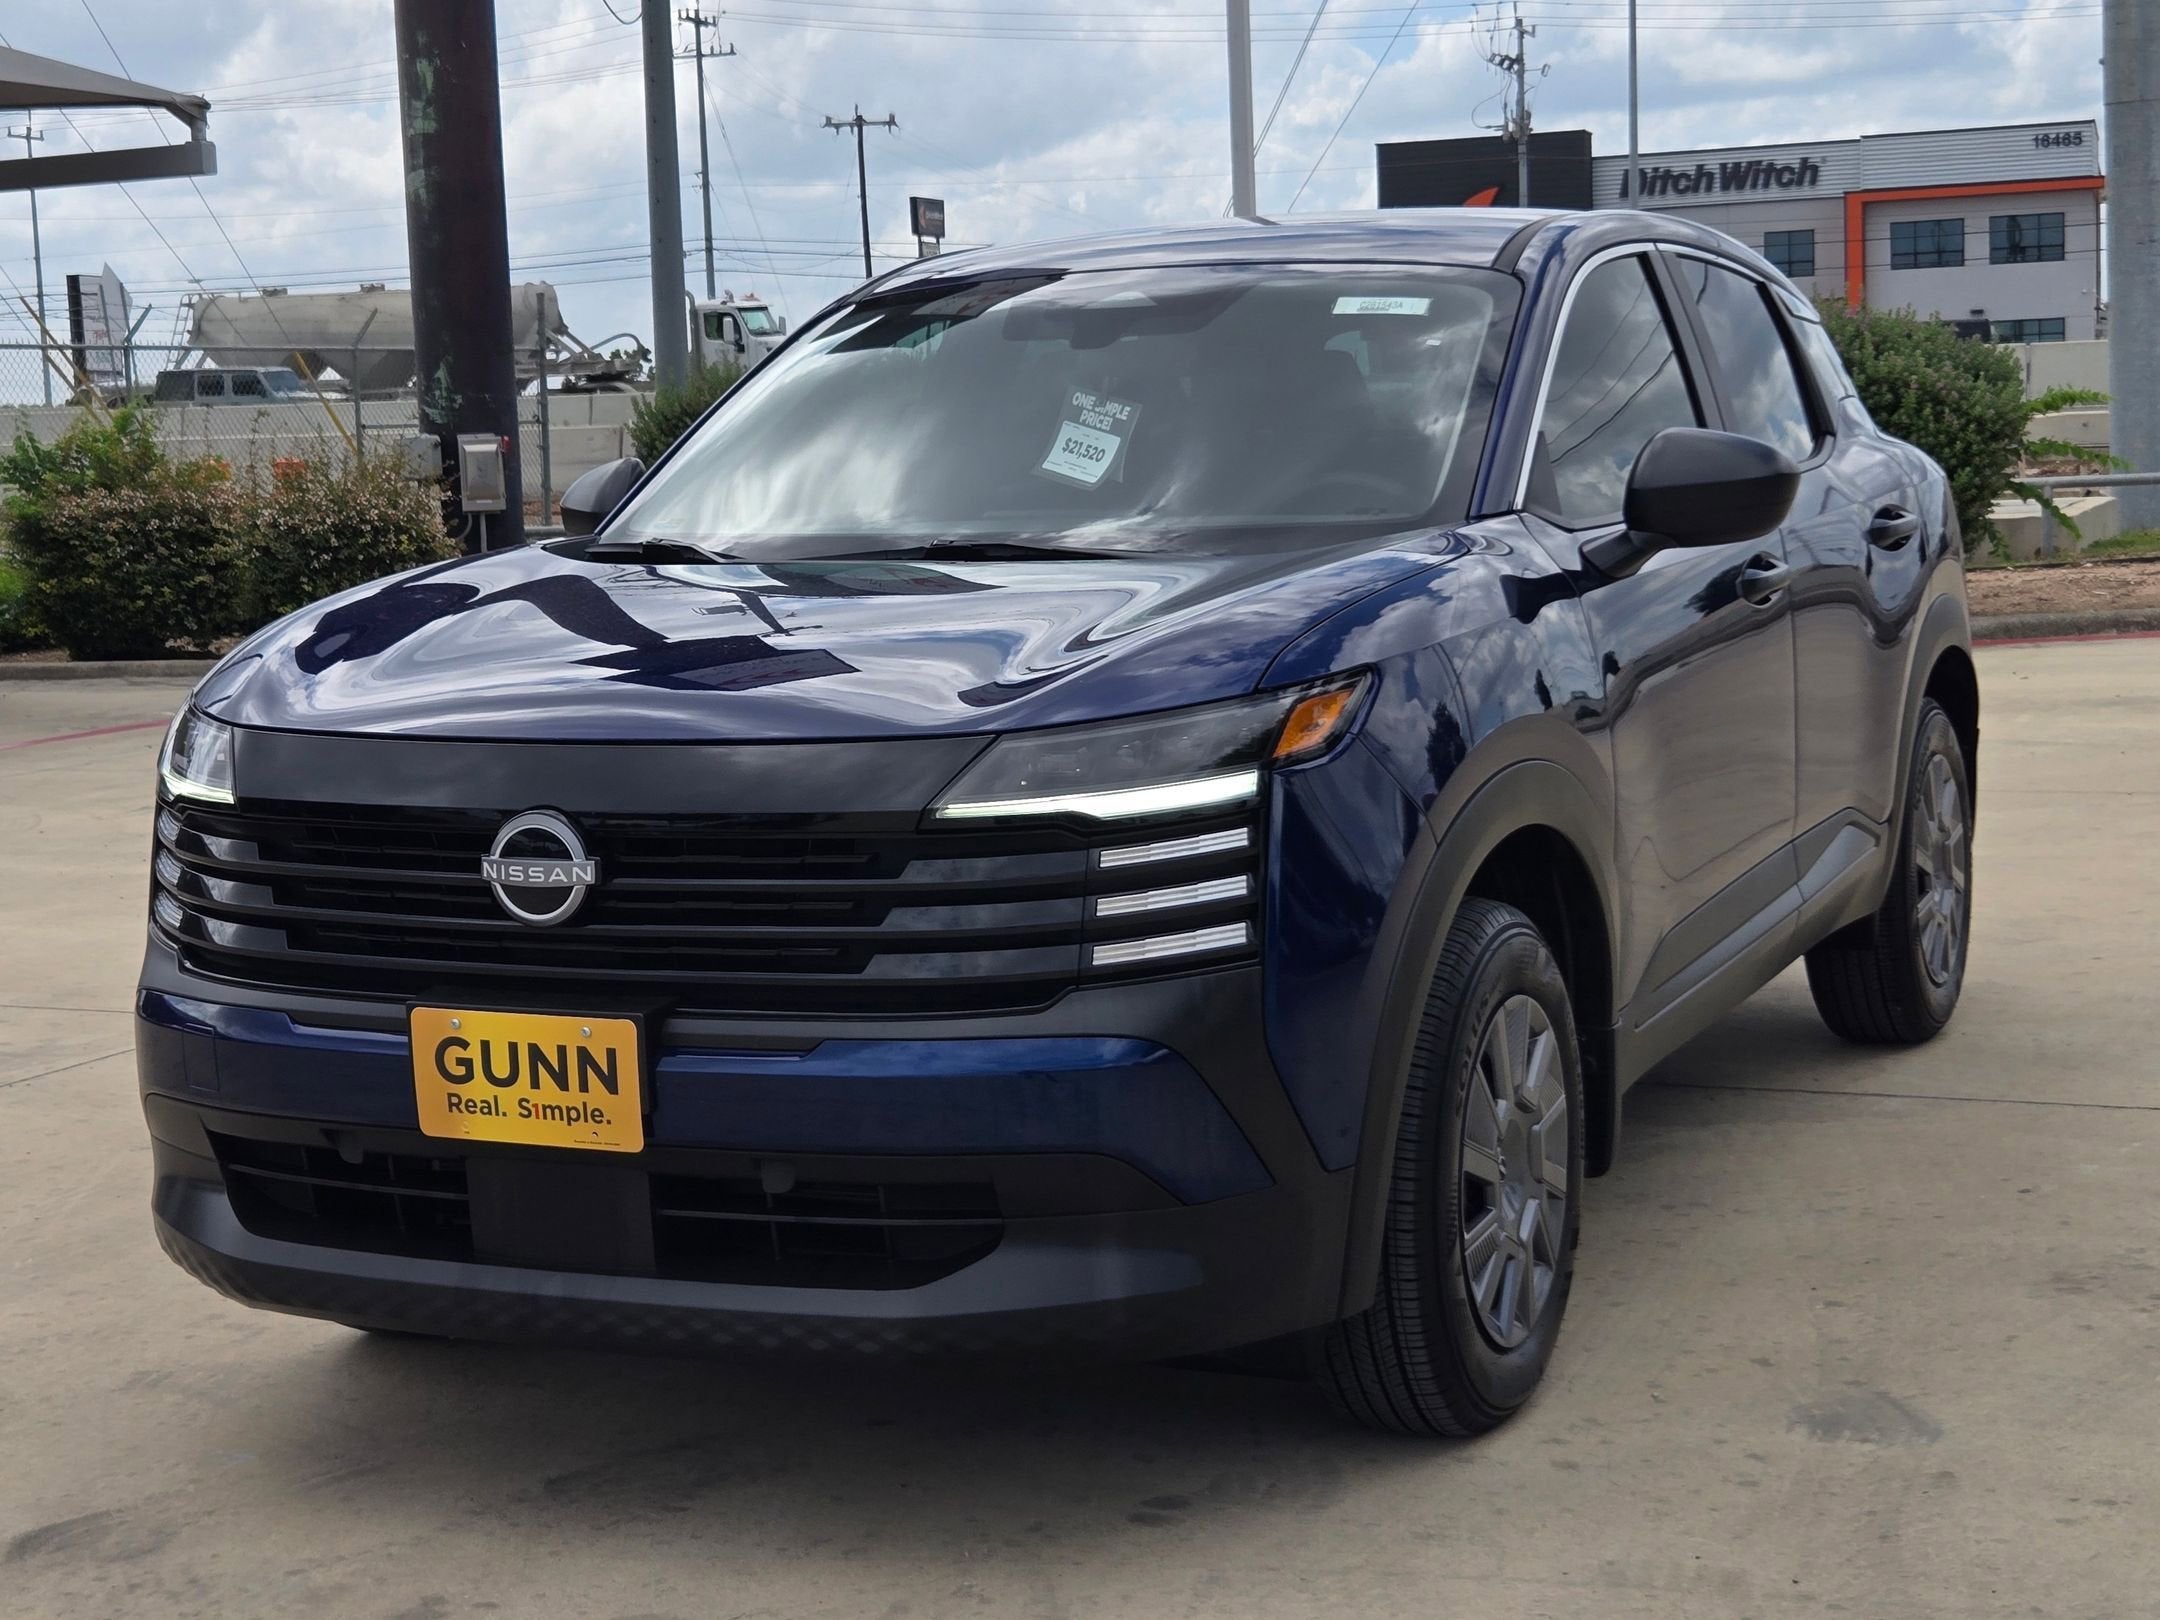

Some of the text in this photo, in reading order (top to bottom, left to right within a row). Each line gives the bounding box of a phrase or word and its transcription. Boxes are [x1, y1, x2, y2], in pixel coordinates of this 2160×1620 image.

[1618, 157, 1820, 199] Ditch Witch
[1072, 392, 1131, 420] ONE MPLE
[1080, 409, 1114, 431] PRICE!
[1062, 437, 1106, 462] $21,520
[483, 861, 592, 883] NISSAN
[435, 1036, 619, 1096] GUNN
[447, 1092, 507, 1117] Real.
